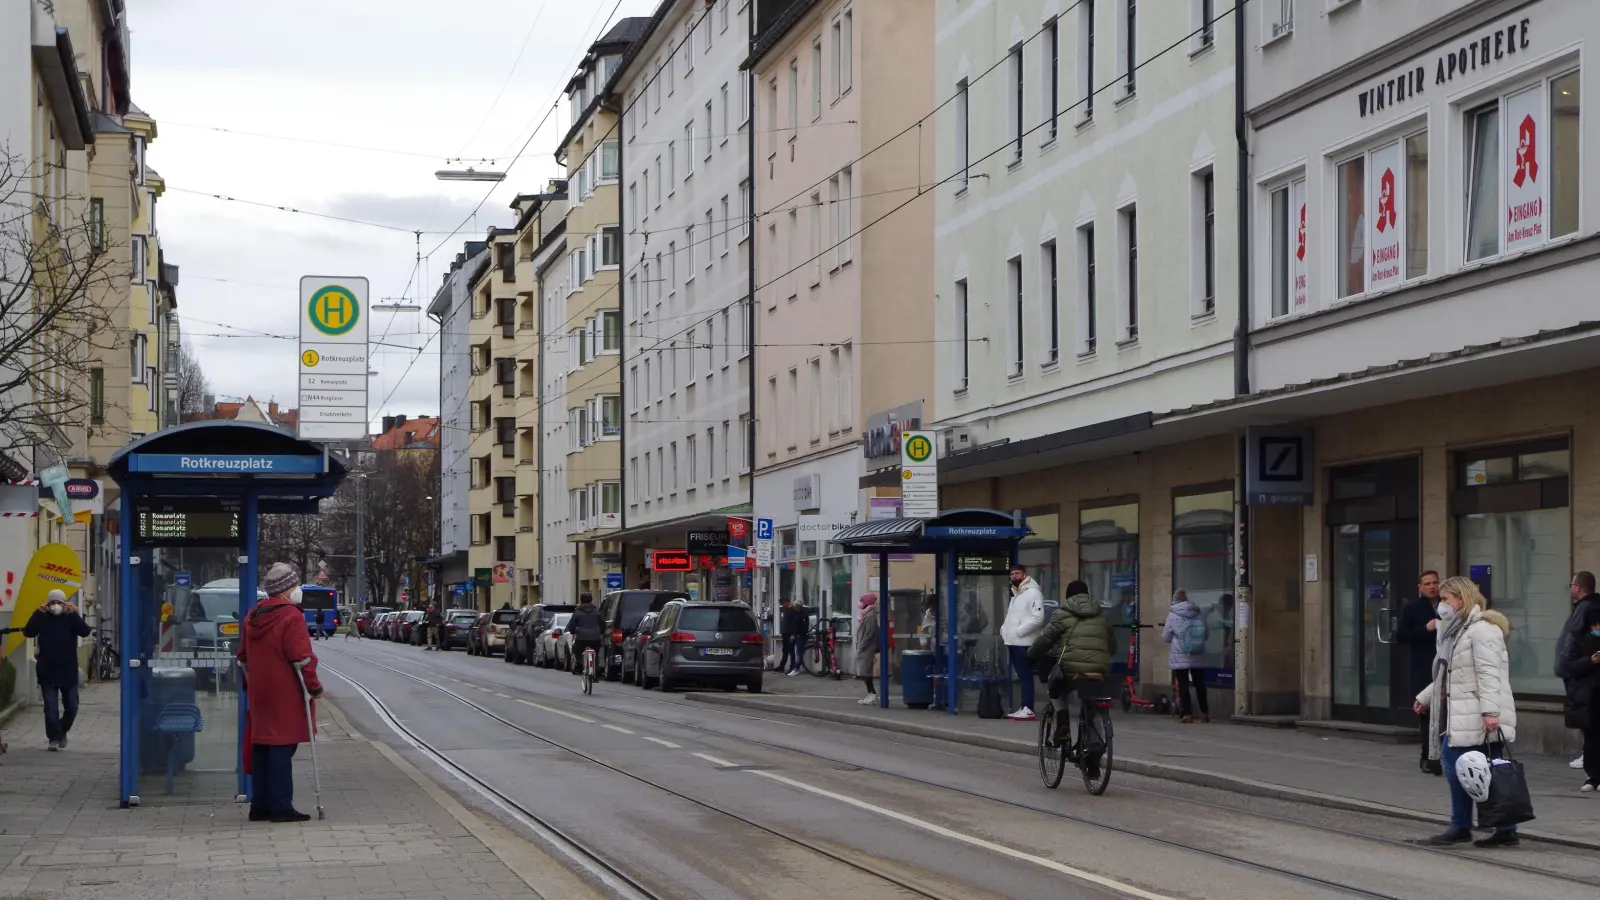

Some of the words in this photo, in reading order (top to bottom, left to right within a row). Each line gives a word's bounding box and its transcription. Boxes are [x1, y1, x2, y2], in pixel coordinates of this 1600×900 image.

[1357, 66, 1426, 118] WINTHIR
[1434, 18, 1531, 86] APOTHEKE
[1513, 199, 1538, 223] EINGANG
[321, 355, 365, 363] Rotkreuzplatz
[180, 456, 274, 471] Rotkreuzplatz
[759, 520, 769, 537] P
[948, 527, 997, 535] Rotkreuzplatz
[690, 532, 727, 541] FRISEUR
[43, 562, 75, 576] DHL
[37, 572, 68, 584] PAKETSHOP
